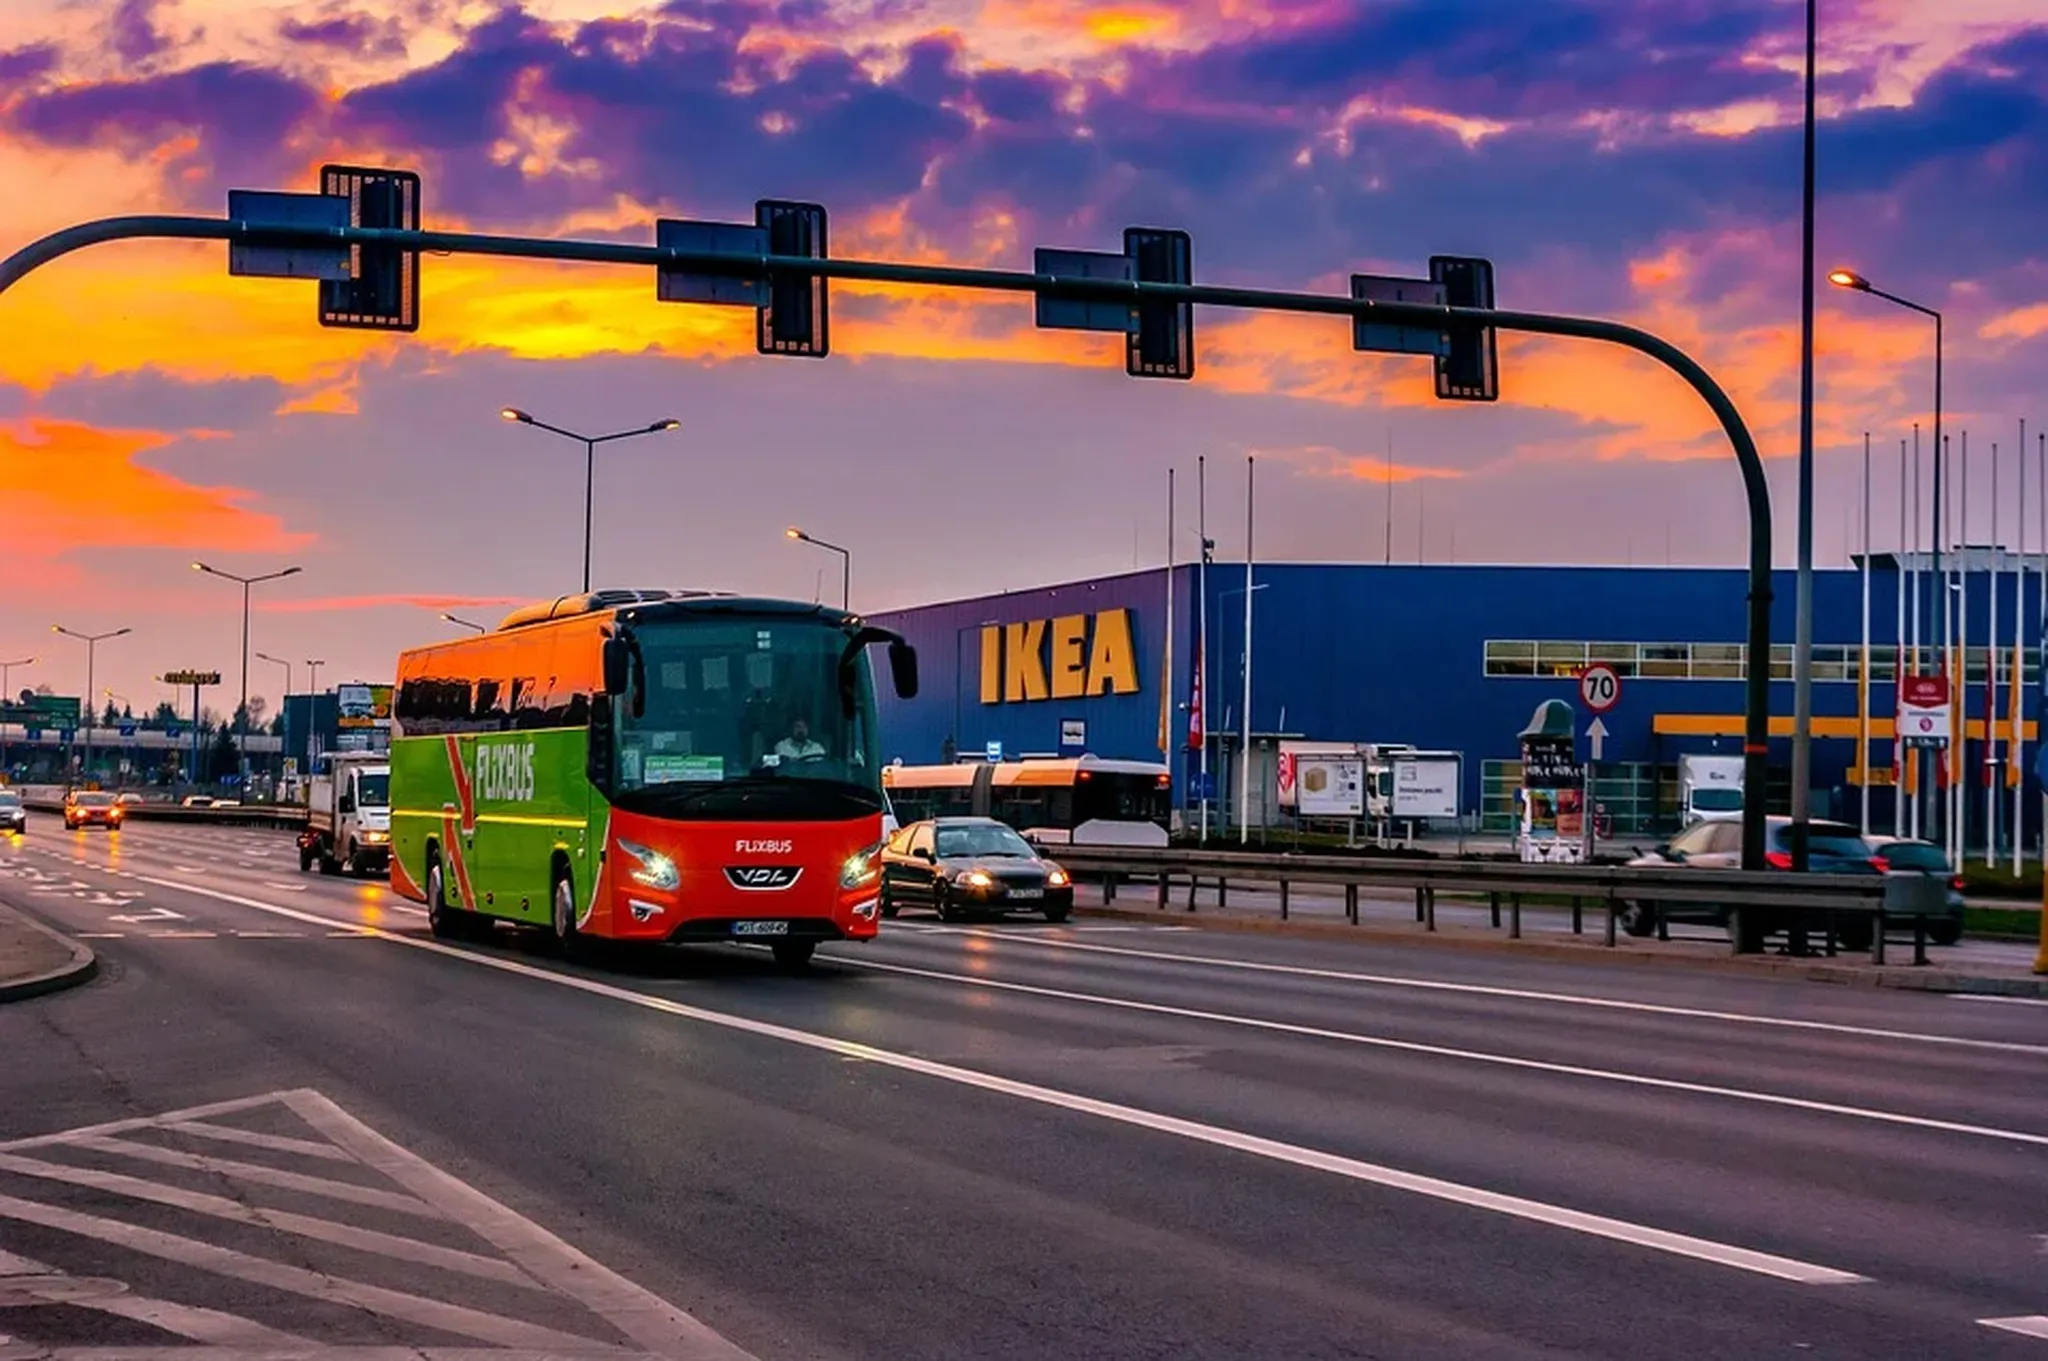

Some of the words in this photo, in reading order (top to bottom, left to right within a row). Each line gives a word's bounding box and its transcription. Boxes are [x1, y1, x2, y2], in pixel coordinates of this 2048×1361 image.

[980, 608, 1139, 704] IKEA
[1587, 676, 1614, 700] 70
[736, 868, 788, 884] VDL
